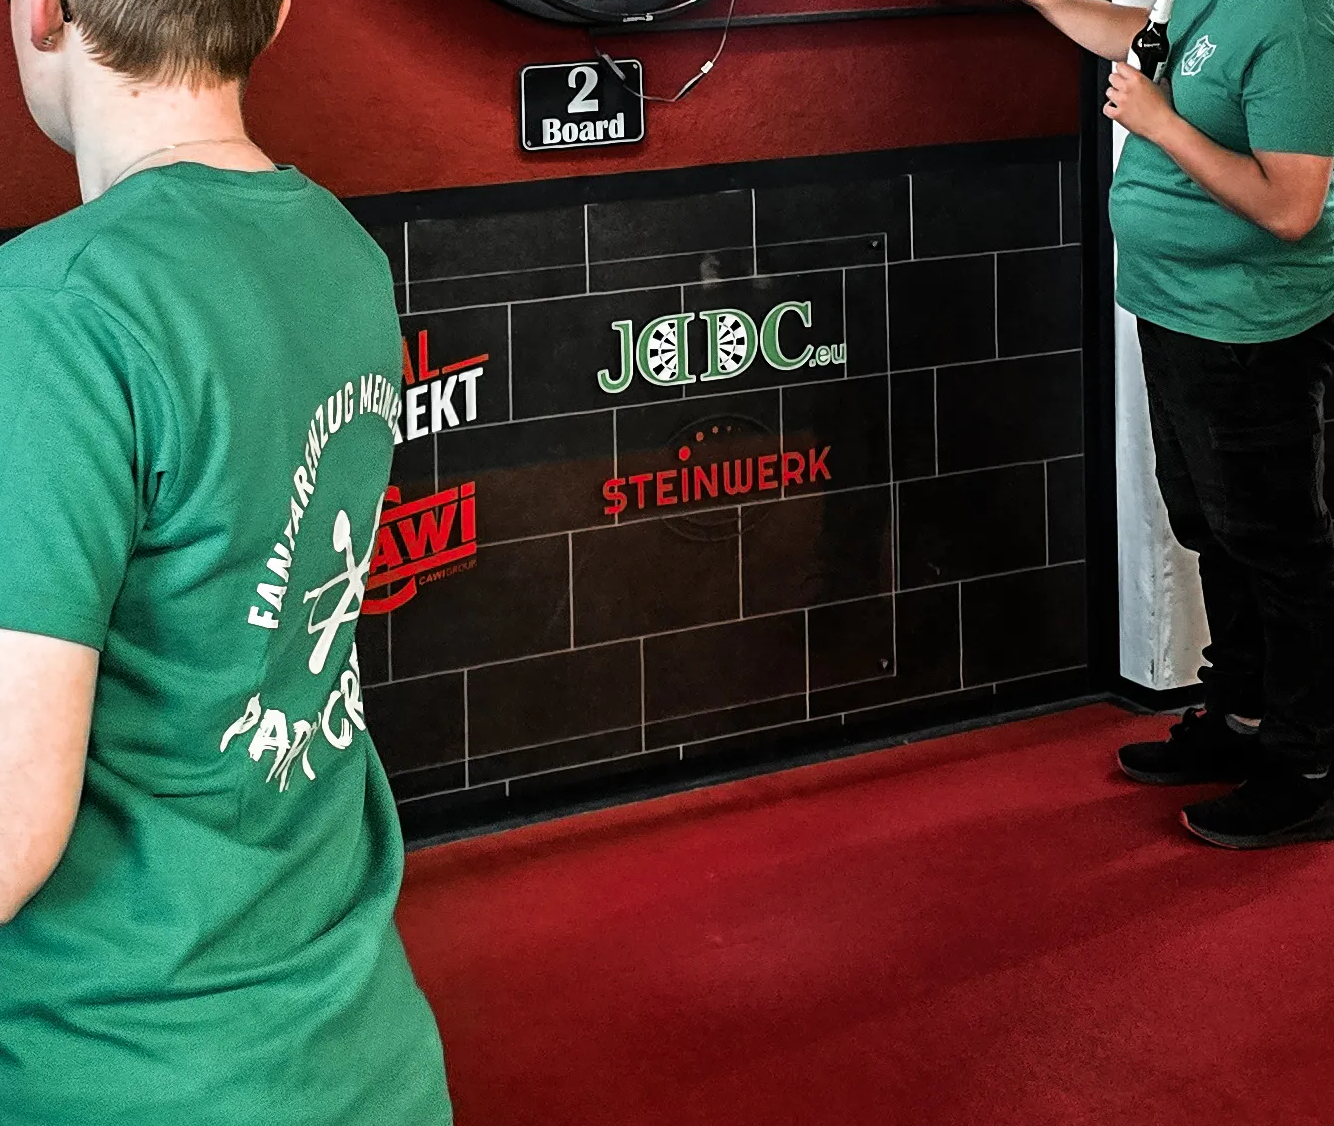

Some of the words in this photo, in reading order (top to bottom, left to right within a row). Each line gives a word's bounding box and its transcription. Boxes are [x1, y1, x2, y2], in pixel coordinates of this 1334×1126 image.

[566, 65, 599, 113] 2
[542, 113, 625, 144] Board
[403, 366, 484, 442] EKT
[602, 444, 833, 516] STEINWERK
